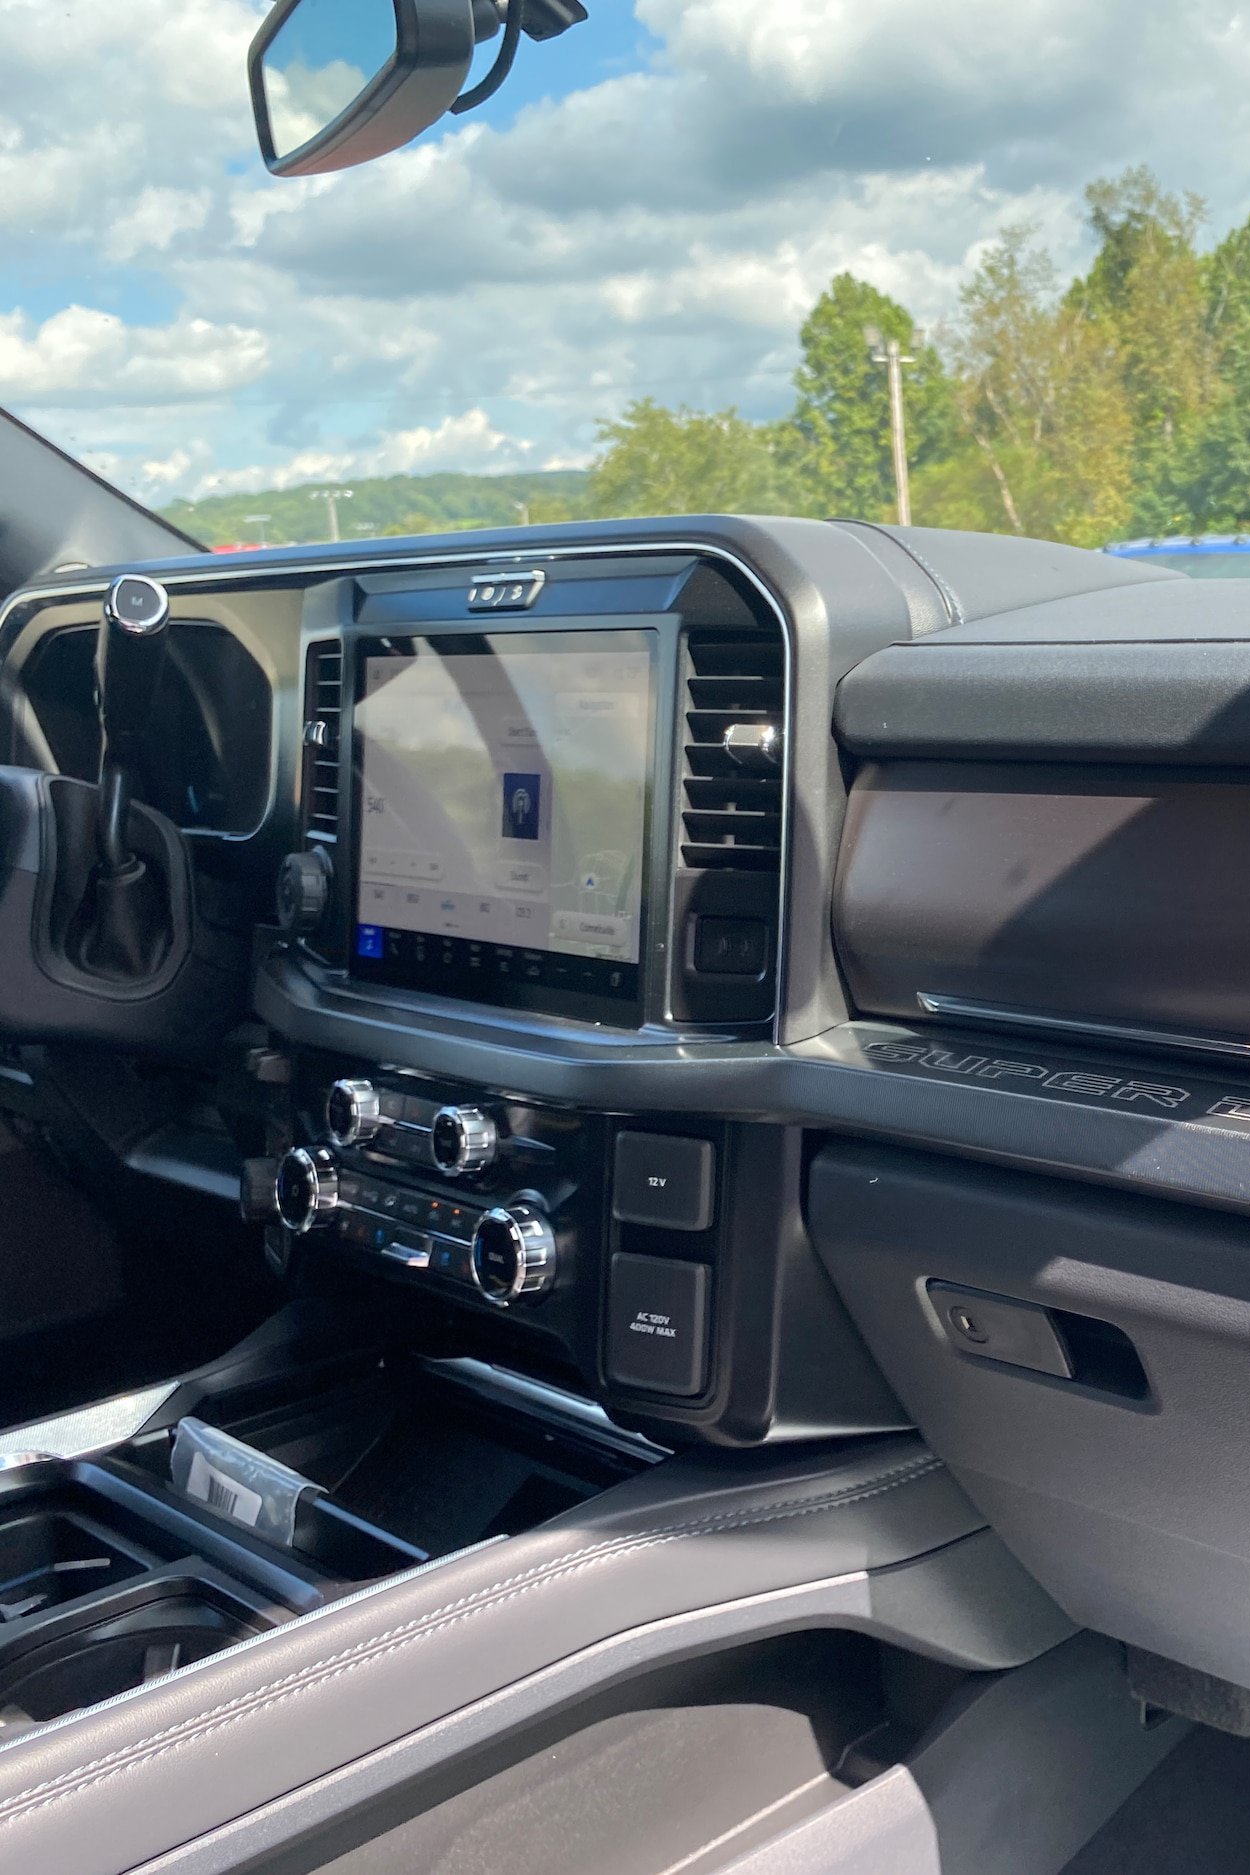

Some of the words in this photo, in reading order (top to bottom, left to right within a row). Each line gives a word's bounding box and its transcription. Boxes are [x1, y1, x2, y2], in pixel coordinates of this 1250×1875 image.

[862, 1041, 1191, 1109] SUPER
[636, 1311, 648, 1322] AC
[648, 1313, 671, 1326] 120V
[656, 1325, 677, 1338] MAX
